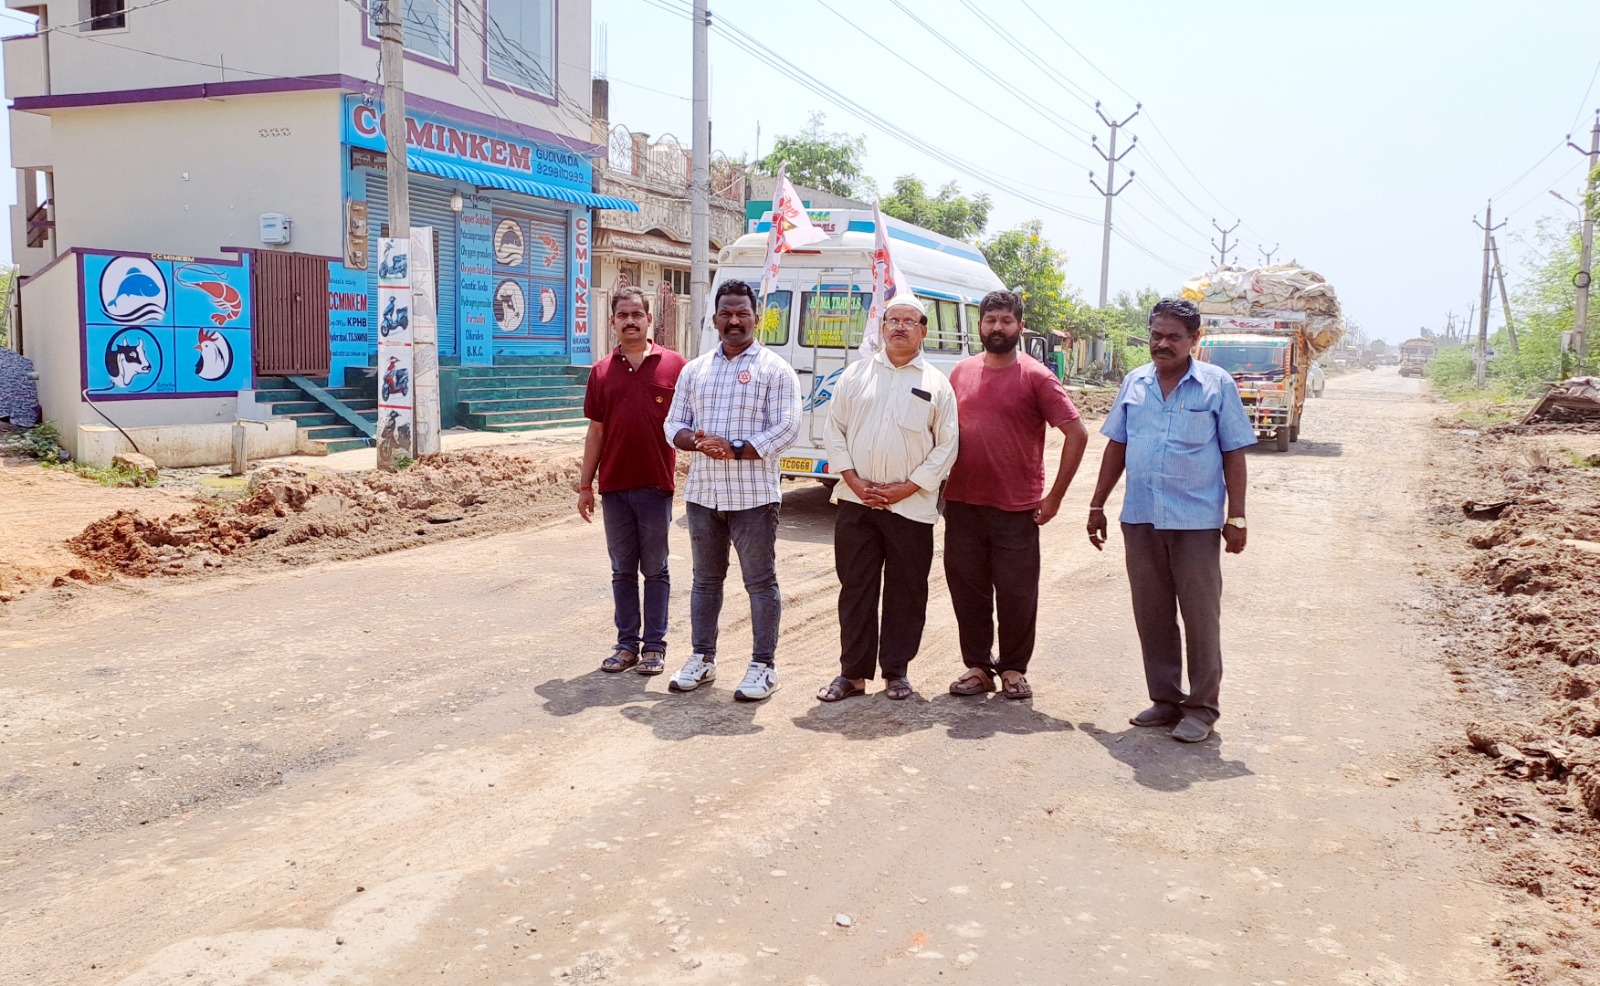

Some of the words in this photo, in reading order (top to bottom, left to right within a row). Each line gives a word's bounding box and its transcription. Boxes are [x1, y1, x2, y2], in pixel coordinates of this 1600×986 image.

[536, 148, 579, 168] GUDIVADA
[347, 316, 367, 327] KPHB
[780, 459, 810, 470] TC0668
